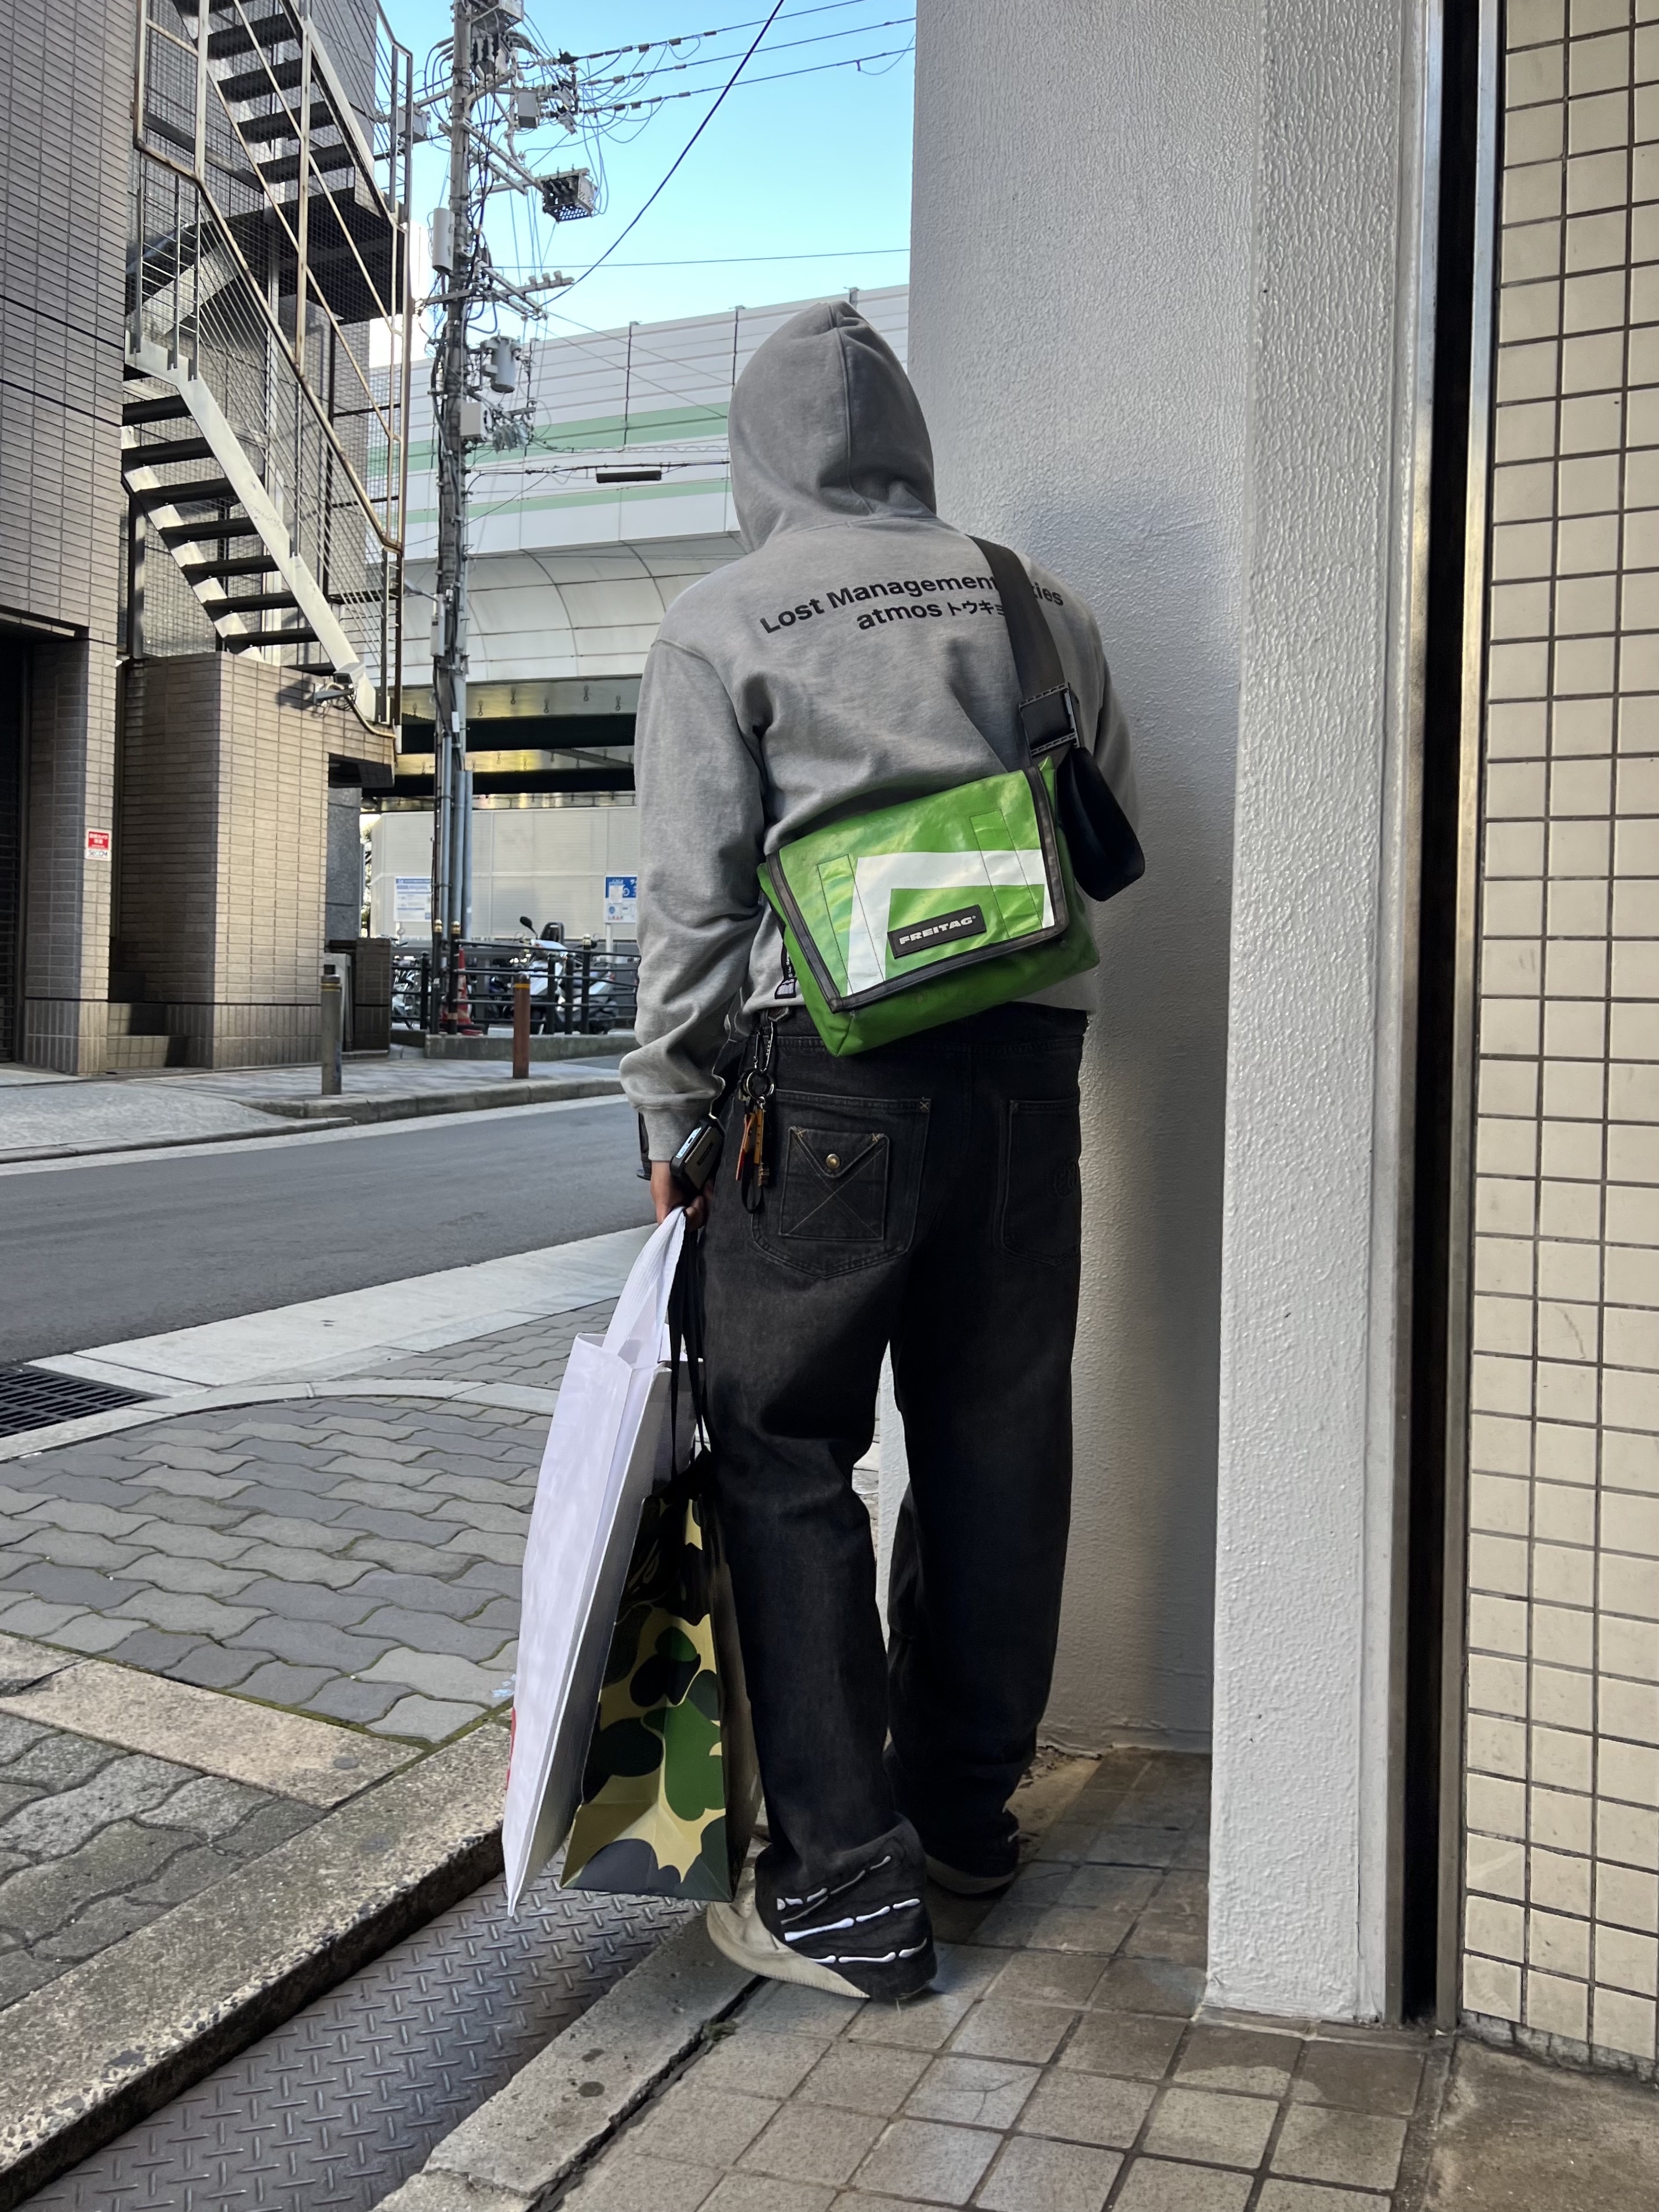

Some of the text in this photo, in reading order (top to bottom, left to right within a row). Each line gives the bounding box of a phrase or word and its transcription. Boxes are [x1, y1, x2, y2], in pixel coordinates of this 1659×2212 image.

[759, 598, 825, 633] Lost
[857, 604, 943, 630] atmos
[899, 916, 973, 945] FREITAG
